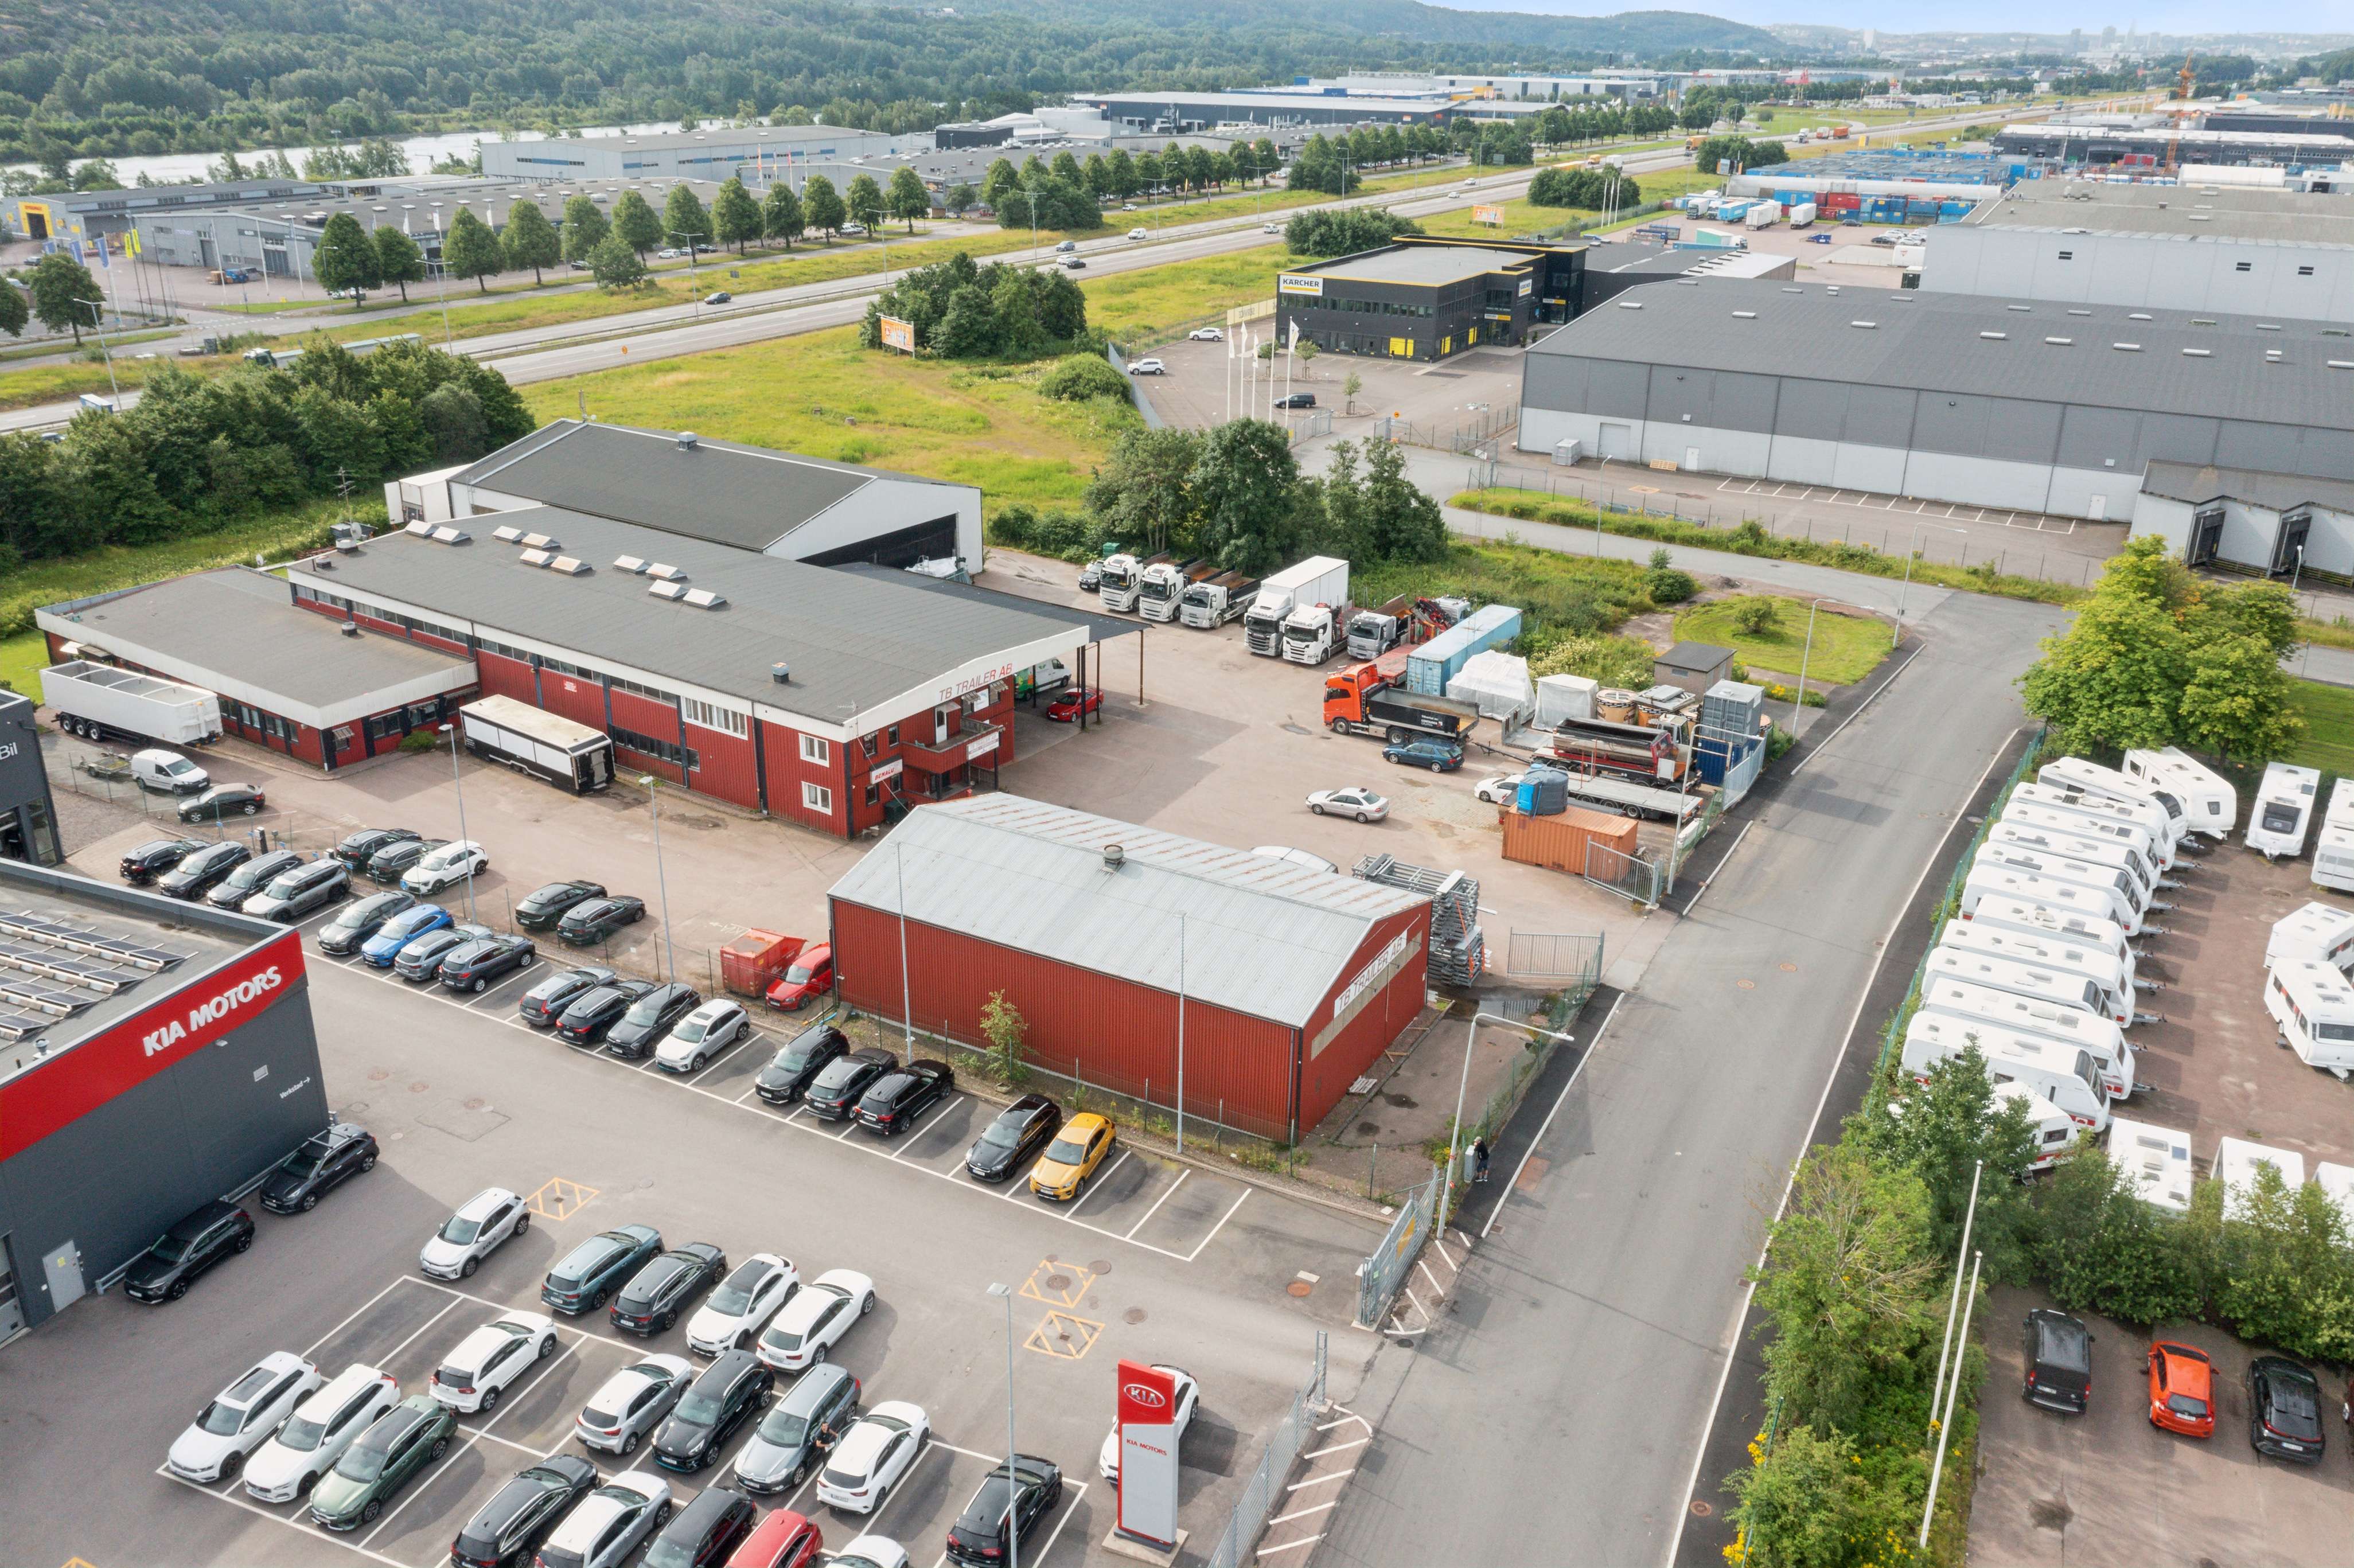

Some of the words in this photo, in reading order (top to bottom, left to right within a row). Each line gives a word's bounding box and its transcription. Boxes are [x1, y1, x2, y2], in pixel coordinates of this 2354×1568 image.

[1283, 278, 1319, 287] KÄRCHER
[940, 687, 952, 701] TB
[956, 670, 996, 695] TRAILER
[999, 663, 1012, 677] AB
[0, 742, 18, 760] Bil
[1339, 988, 1351, 1011] TB
[1354, 951, 1388, 995] TRAILER
[1390, 937, 1402, 959] AB
[143, 1021, 187, 1057] KIA
[189, 966, 282, 1032] MOTORS
[280, 1081, 303, 1099] Verkstad
[1131, 1387, 1159, 1405] KIA
[1126, 1438, 1138, 1447] KIA
[1140, 1442, 1167, 1456] MOTORS
